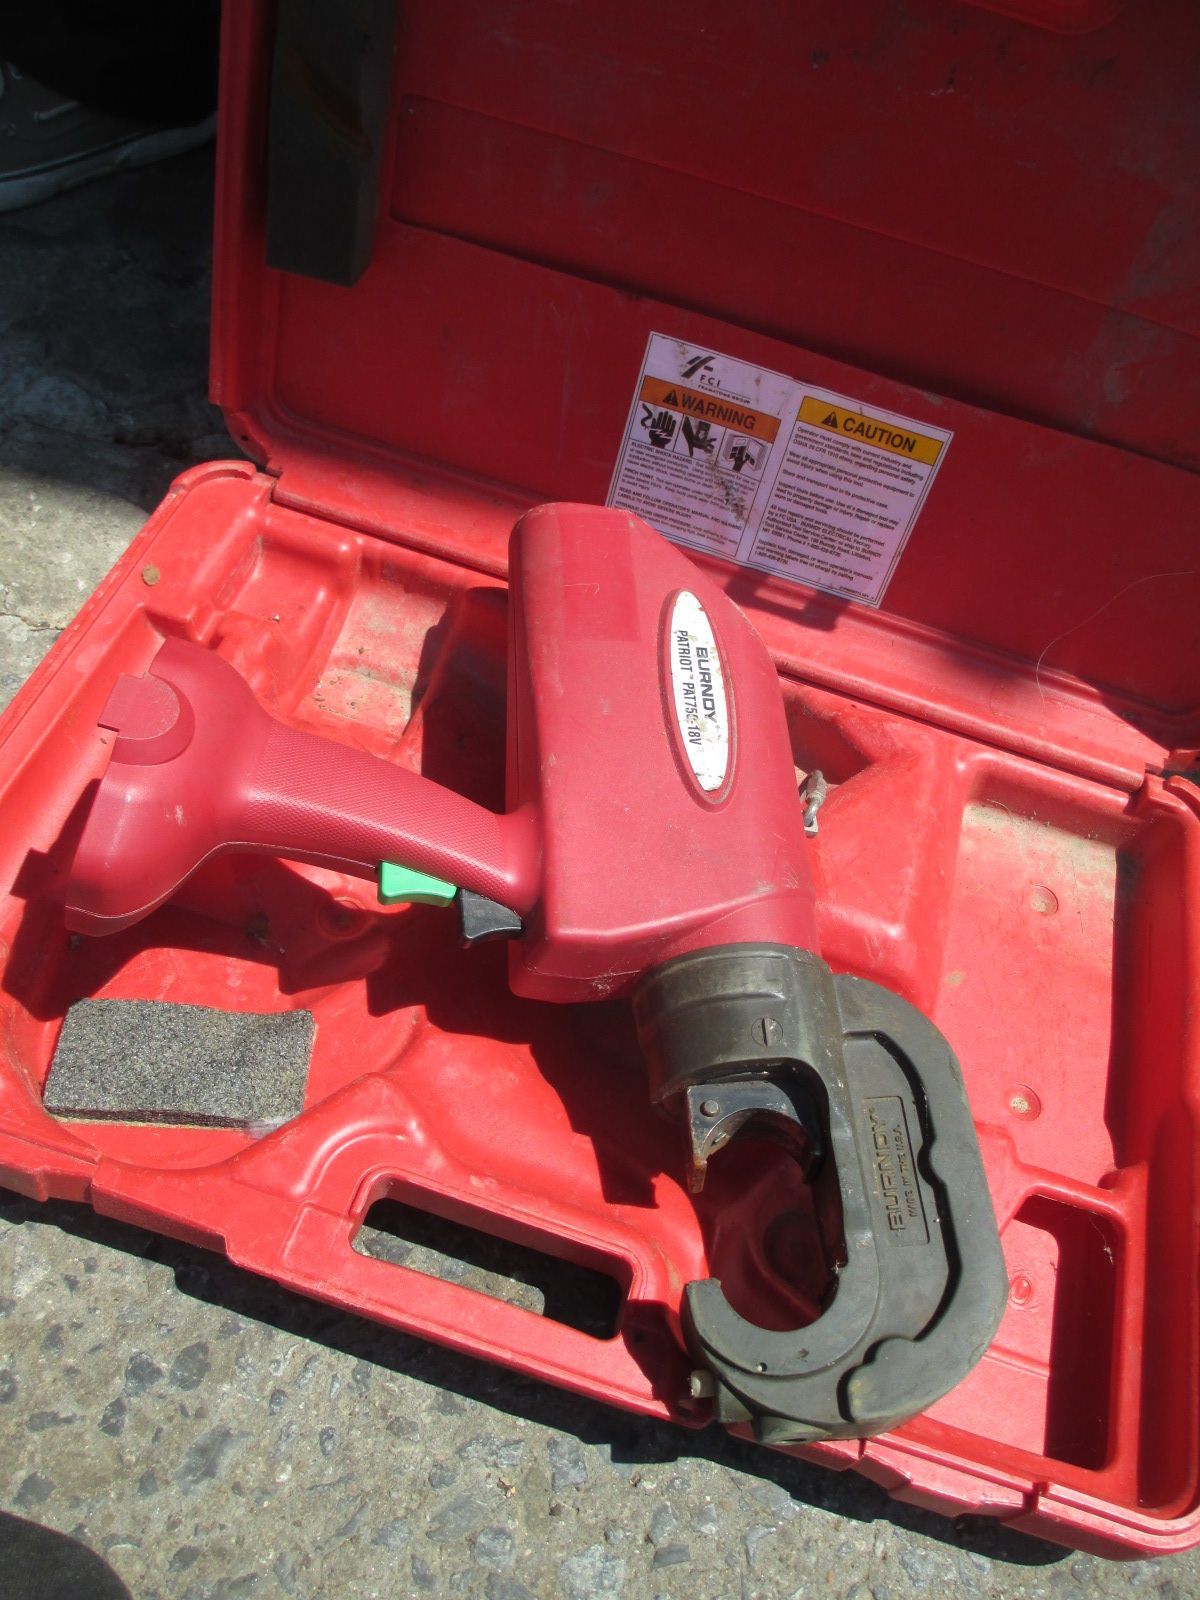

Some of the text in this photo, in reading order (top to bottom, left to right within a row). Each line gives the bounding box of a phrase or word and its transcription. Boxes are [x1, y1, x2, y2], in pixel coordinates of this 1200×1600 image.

[700, 374, 720, 386] FCI
[682, 394, 756, 430] WARNING
[843, 417, 916, 452] CAUTION
[696, 646, 717, 723] BURNDY
